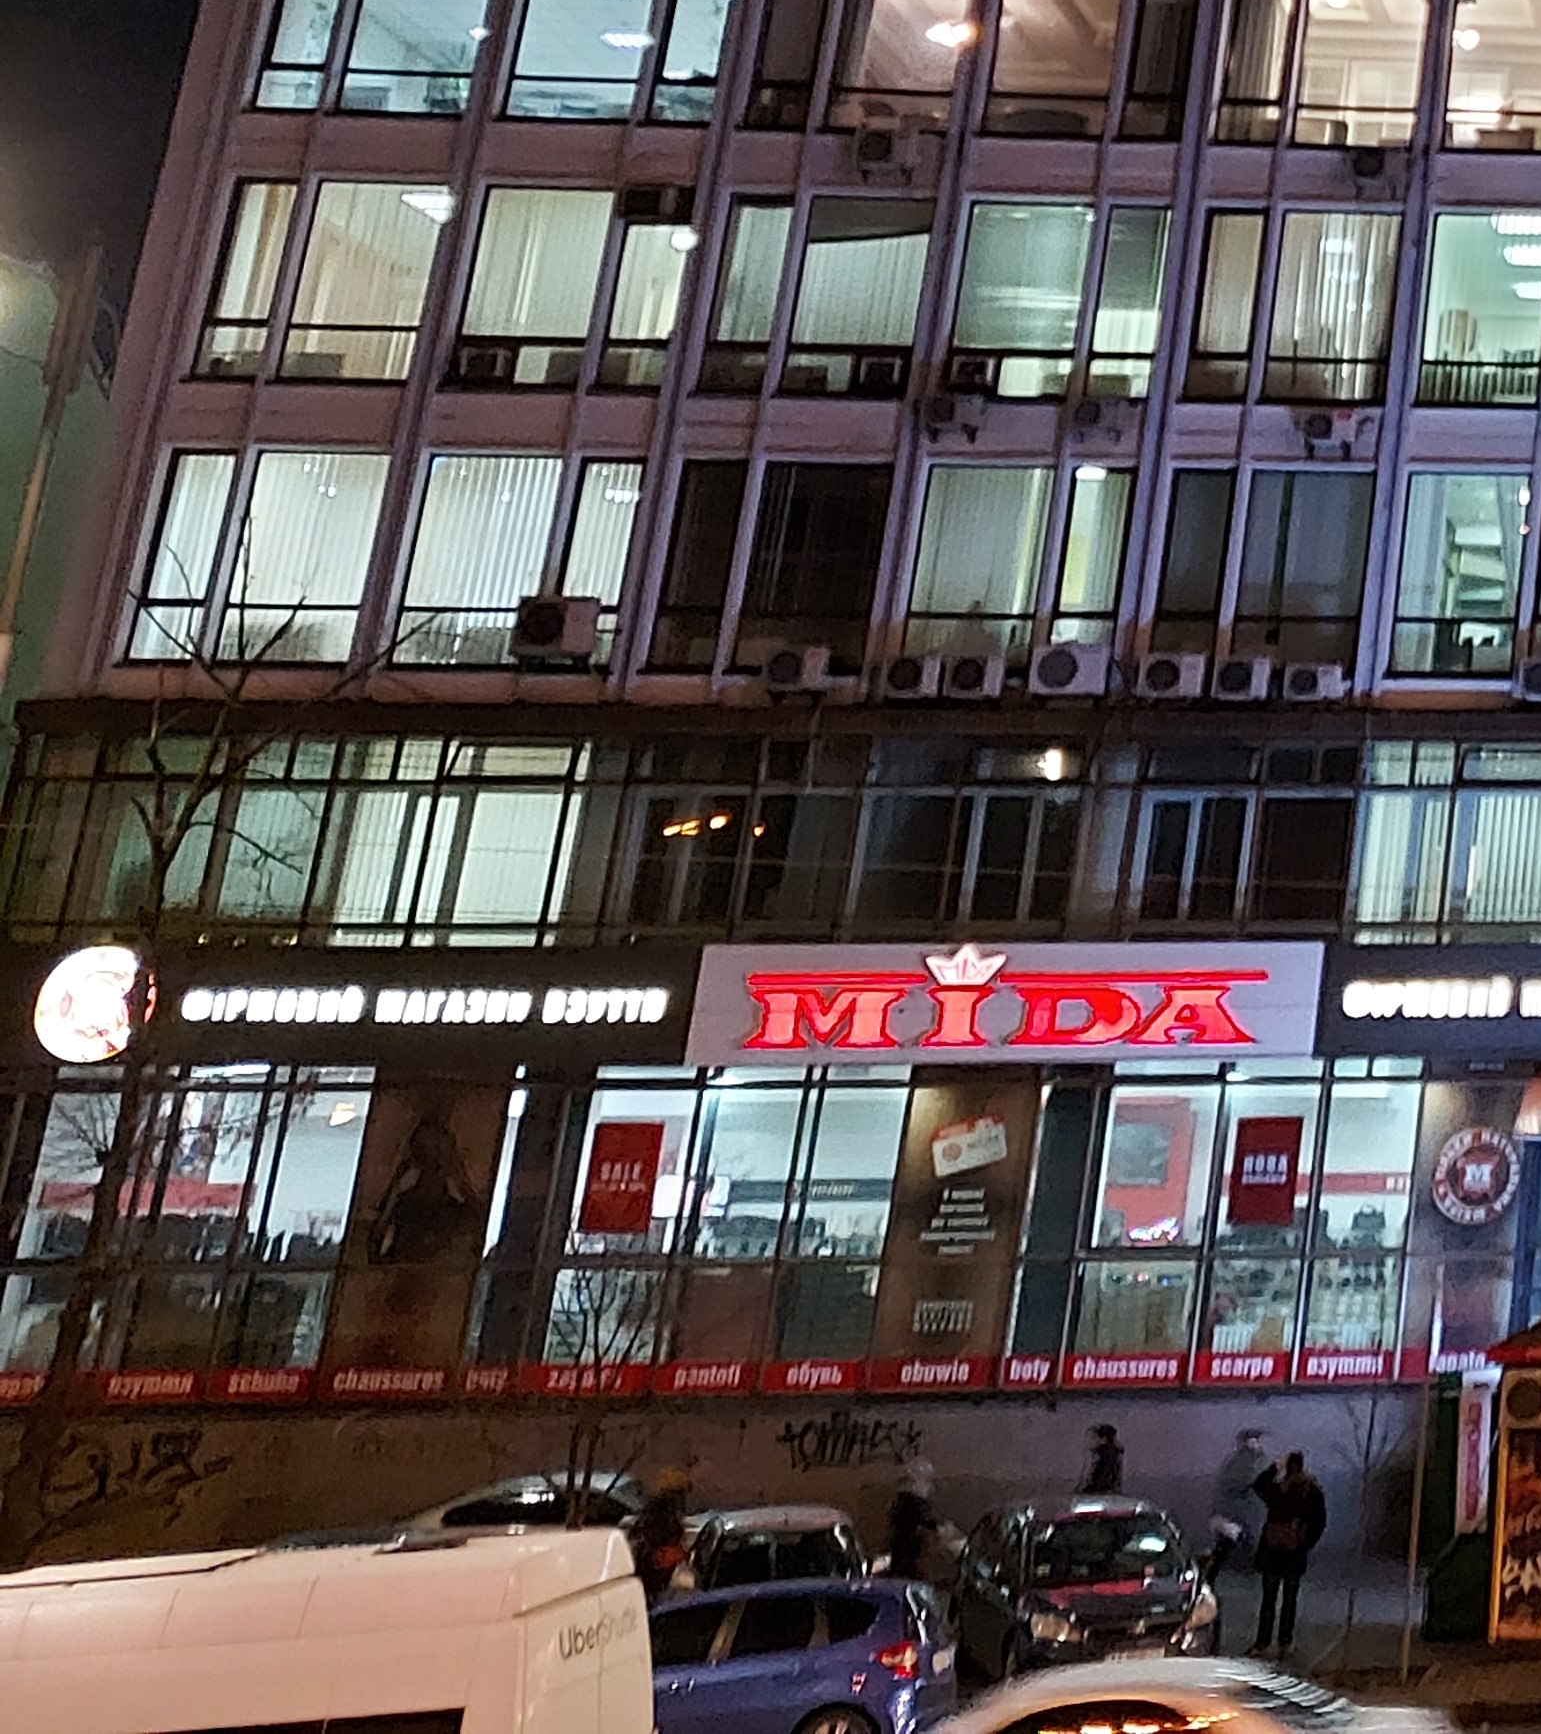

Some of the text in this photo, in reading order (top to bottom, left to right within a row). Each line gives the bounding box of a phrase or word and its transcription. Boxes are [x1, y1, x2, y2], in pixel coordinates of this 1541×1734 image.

[374, 988, 532, 1024] МАГАЗИН
[541, 988, 669, 1024] ВЗУТТЯ
[741, 984, 1258, 1049] MIDA
[1072, 1356, 1179, 1381] chaussures
[1210, 1356, 1274, 1380] scarpe
